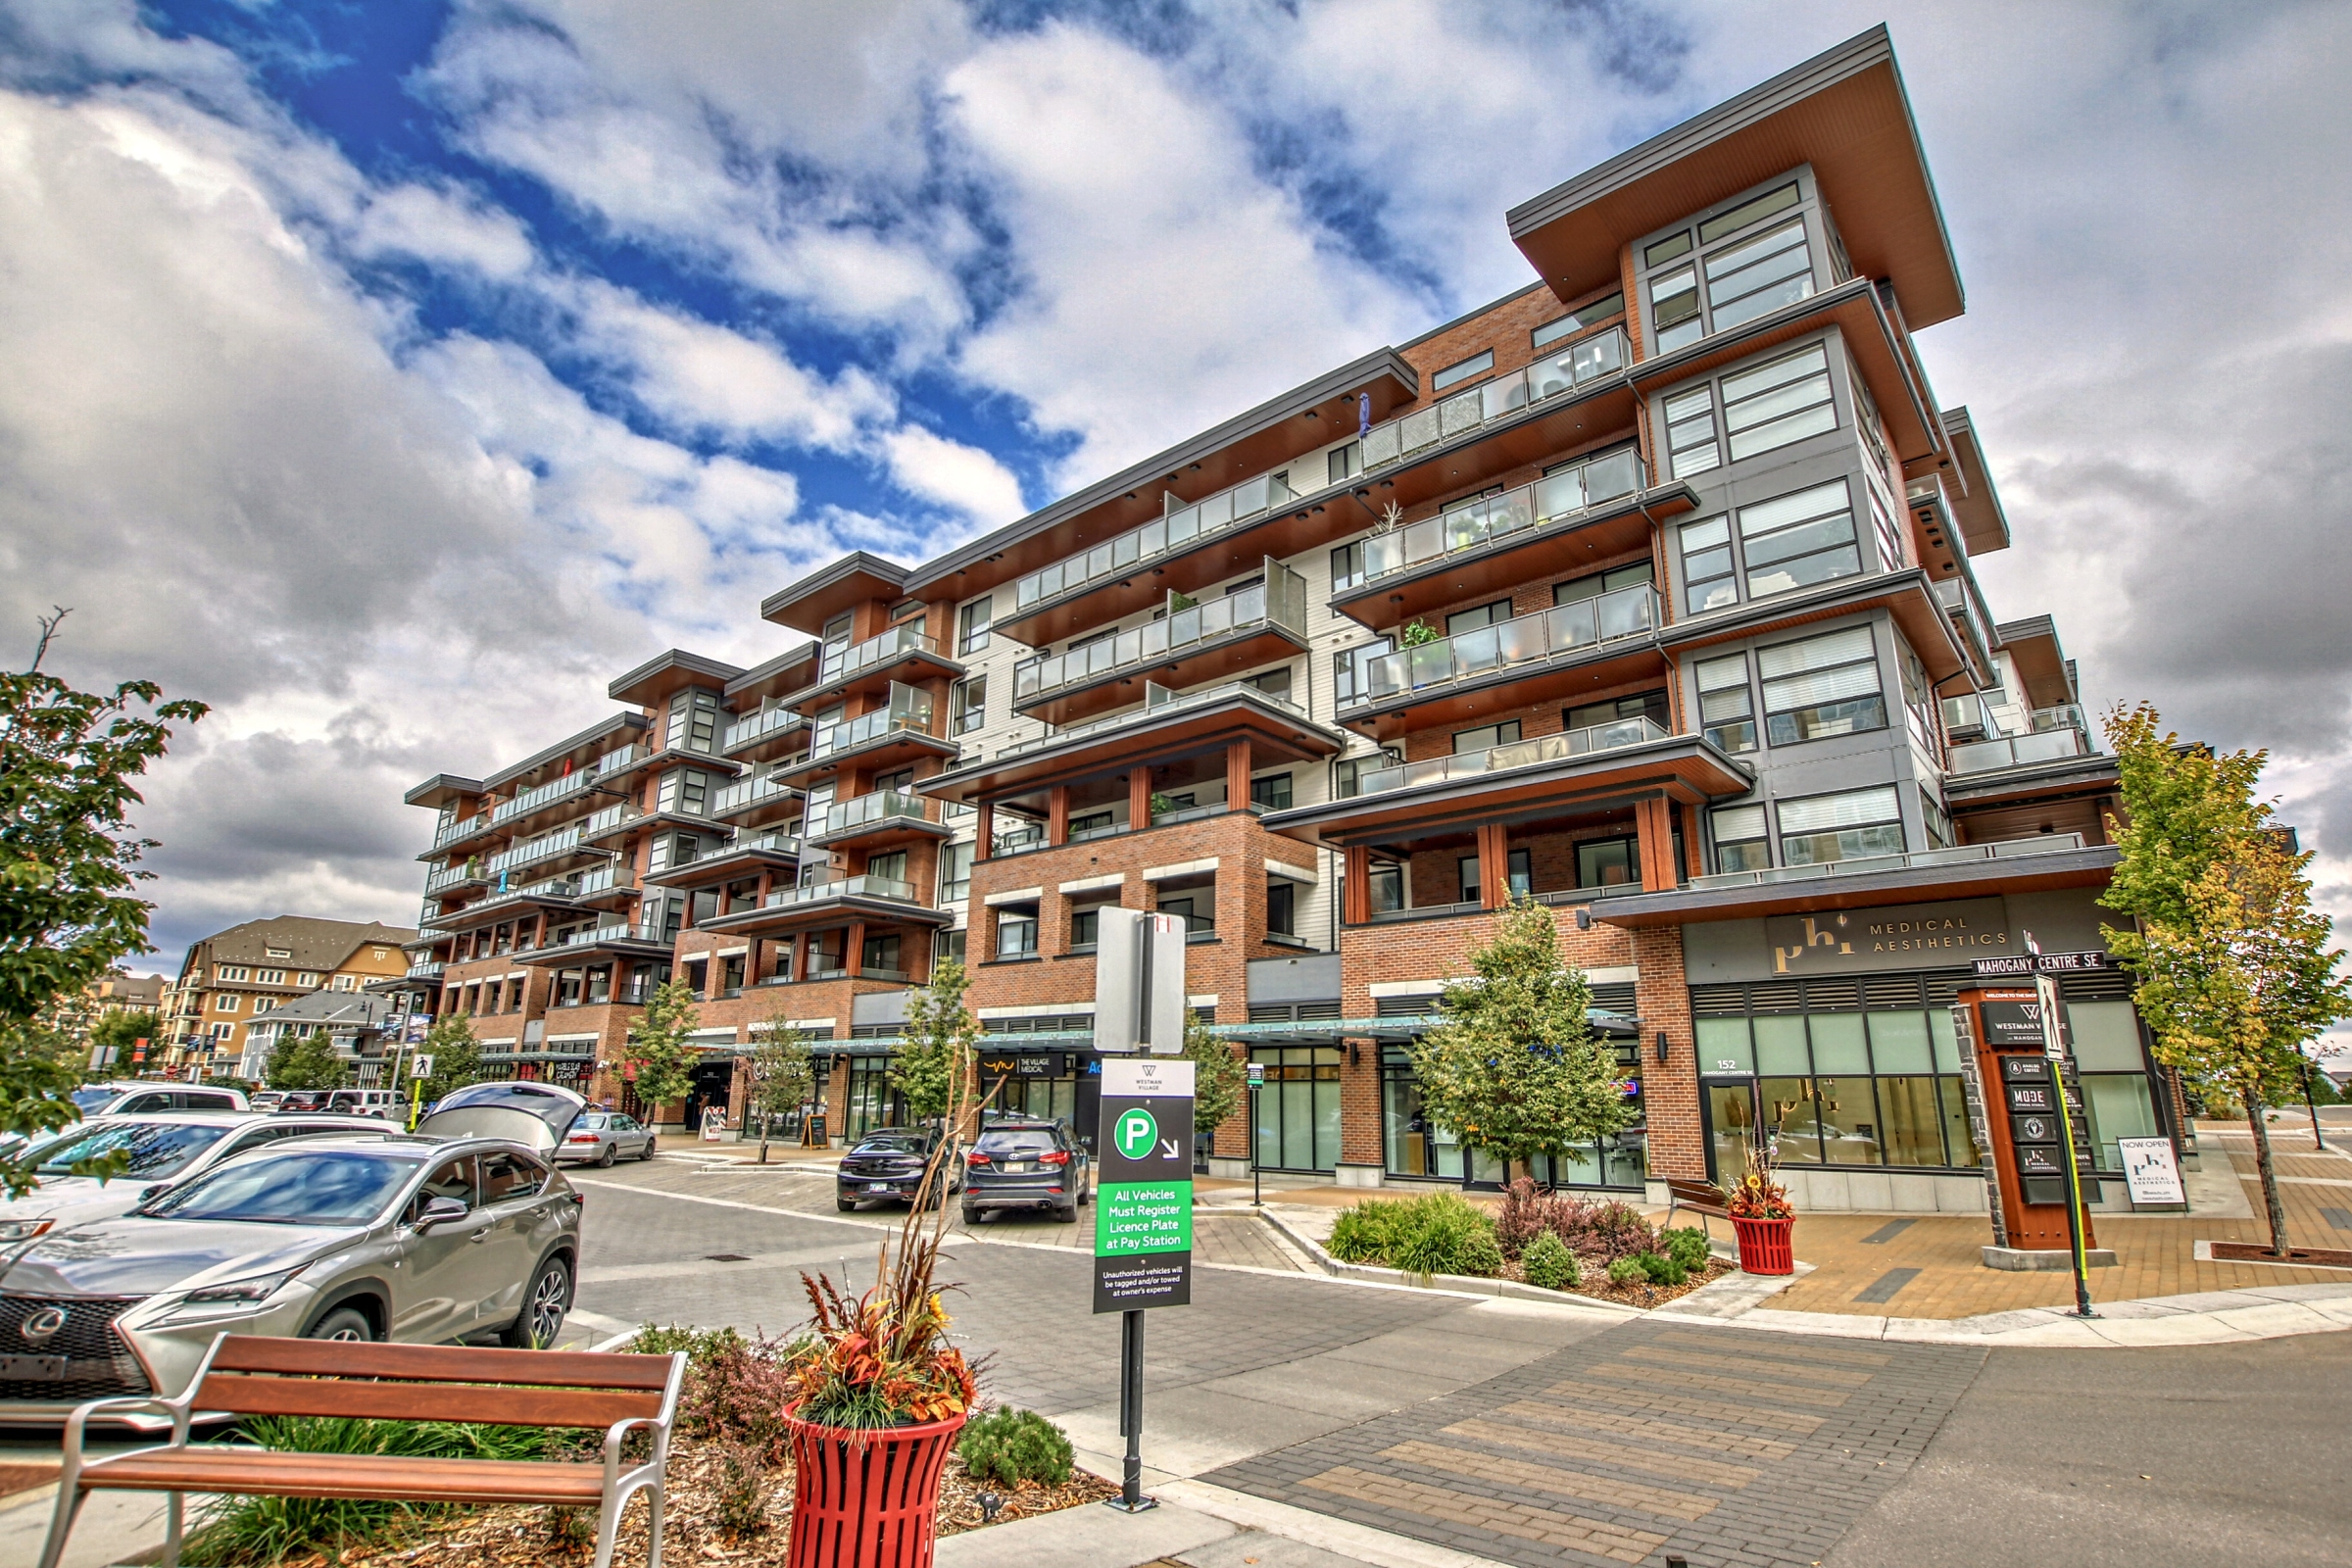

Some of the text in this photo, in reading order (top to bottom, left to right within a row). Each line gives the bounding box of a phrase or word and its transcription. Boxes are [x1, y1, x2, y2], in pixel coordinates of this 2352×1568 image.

[1870, 918, 1967, 935] MEDICAL
[1775, 913, 1855, 974] phi
[1874, 932, 2006, 953] AESTHETICS
[1977, 954, 2099, 973] MAHOGANY CENTRE SE
[1717, 1059, 1737, 1069] 152
[2014, 1090, 2044, 1102] MODE
[1125, 1117, 1151, 1151] P
[1115, 1189, 1176, 1201] All Vehicles
[1108, 1204, 1181, 1218] Must Register
[1109, 1220, 1179, 1233] Licence Plate
[1105, 1235, 1181, 1250] at Pay Station
[1102, 1269, 1146, 1279] Unauthorized
[1114, 1279, 1137, 1289] tagged
[1138, 1277, 1160, 1286] and/or
[1121, 1288, 1146, 1297] owner's
[1146, 1286, 1172, 1295] expense
